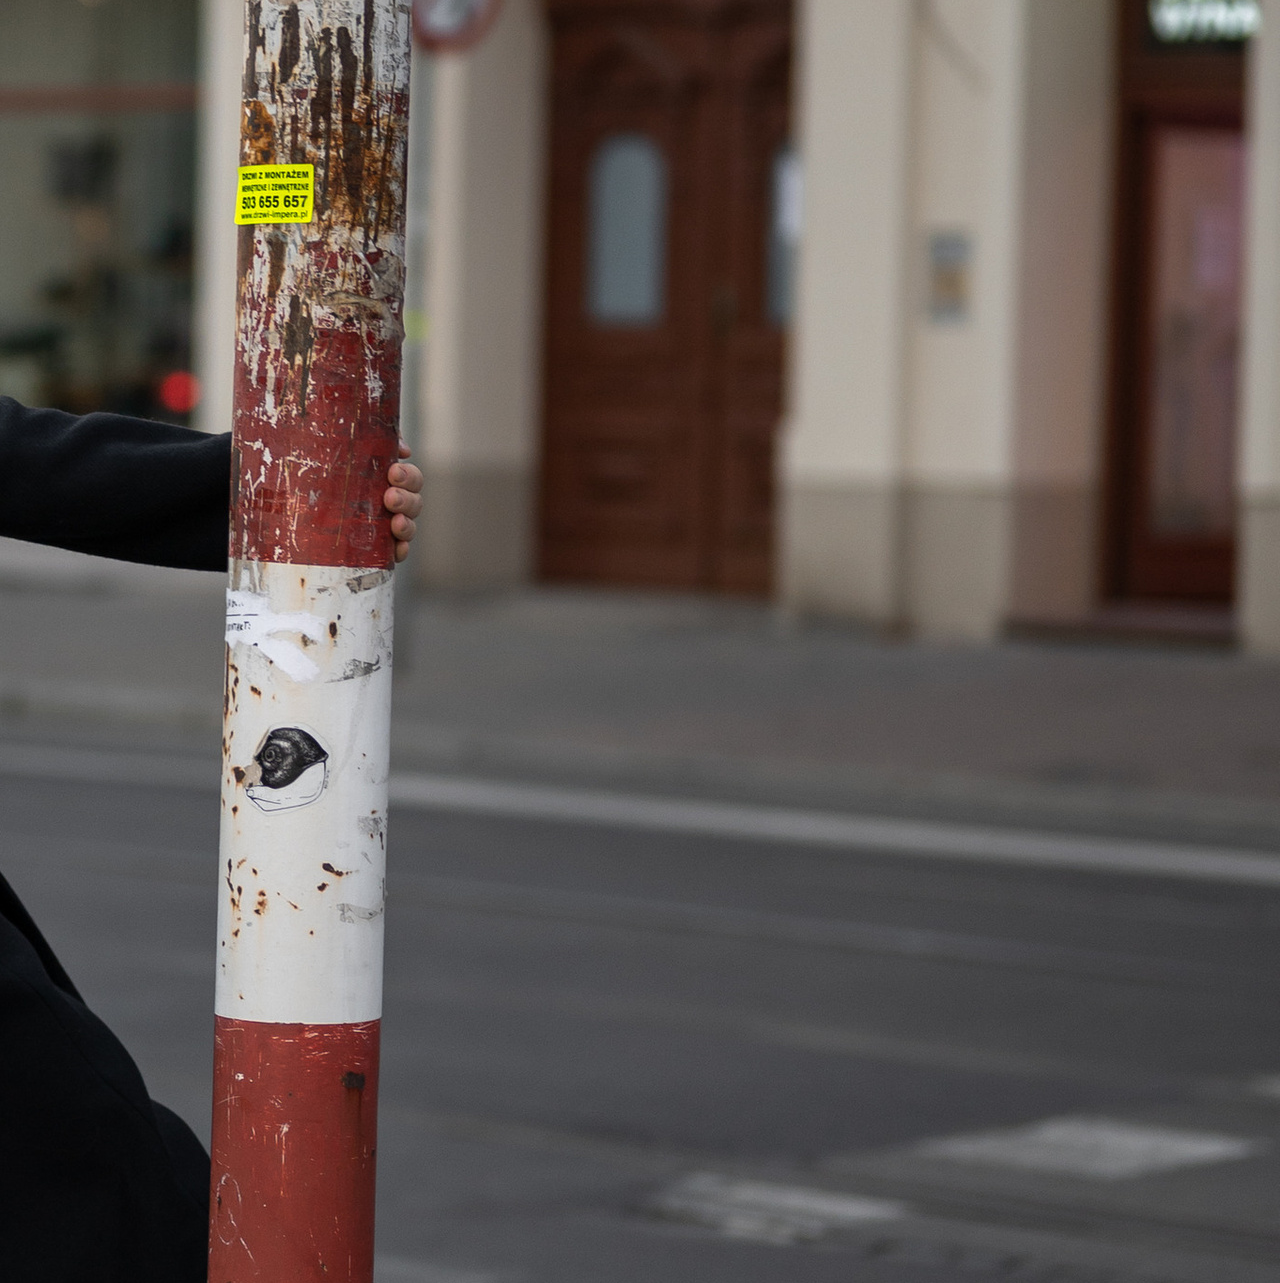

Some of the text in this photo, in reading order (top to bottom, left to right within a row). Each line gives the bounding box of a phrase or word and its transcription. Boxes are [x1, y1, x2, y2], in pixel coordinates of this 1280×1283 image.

[242, 169, 309, 181] DRZWI Z MONTAŻEM
[271, 183, 309, 193] ZEWNĘTRZNE
[242, 195, 308, 210] 503 655 657
[241, 210, 308, 220] www.drzwi-impera.pl
